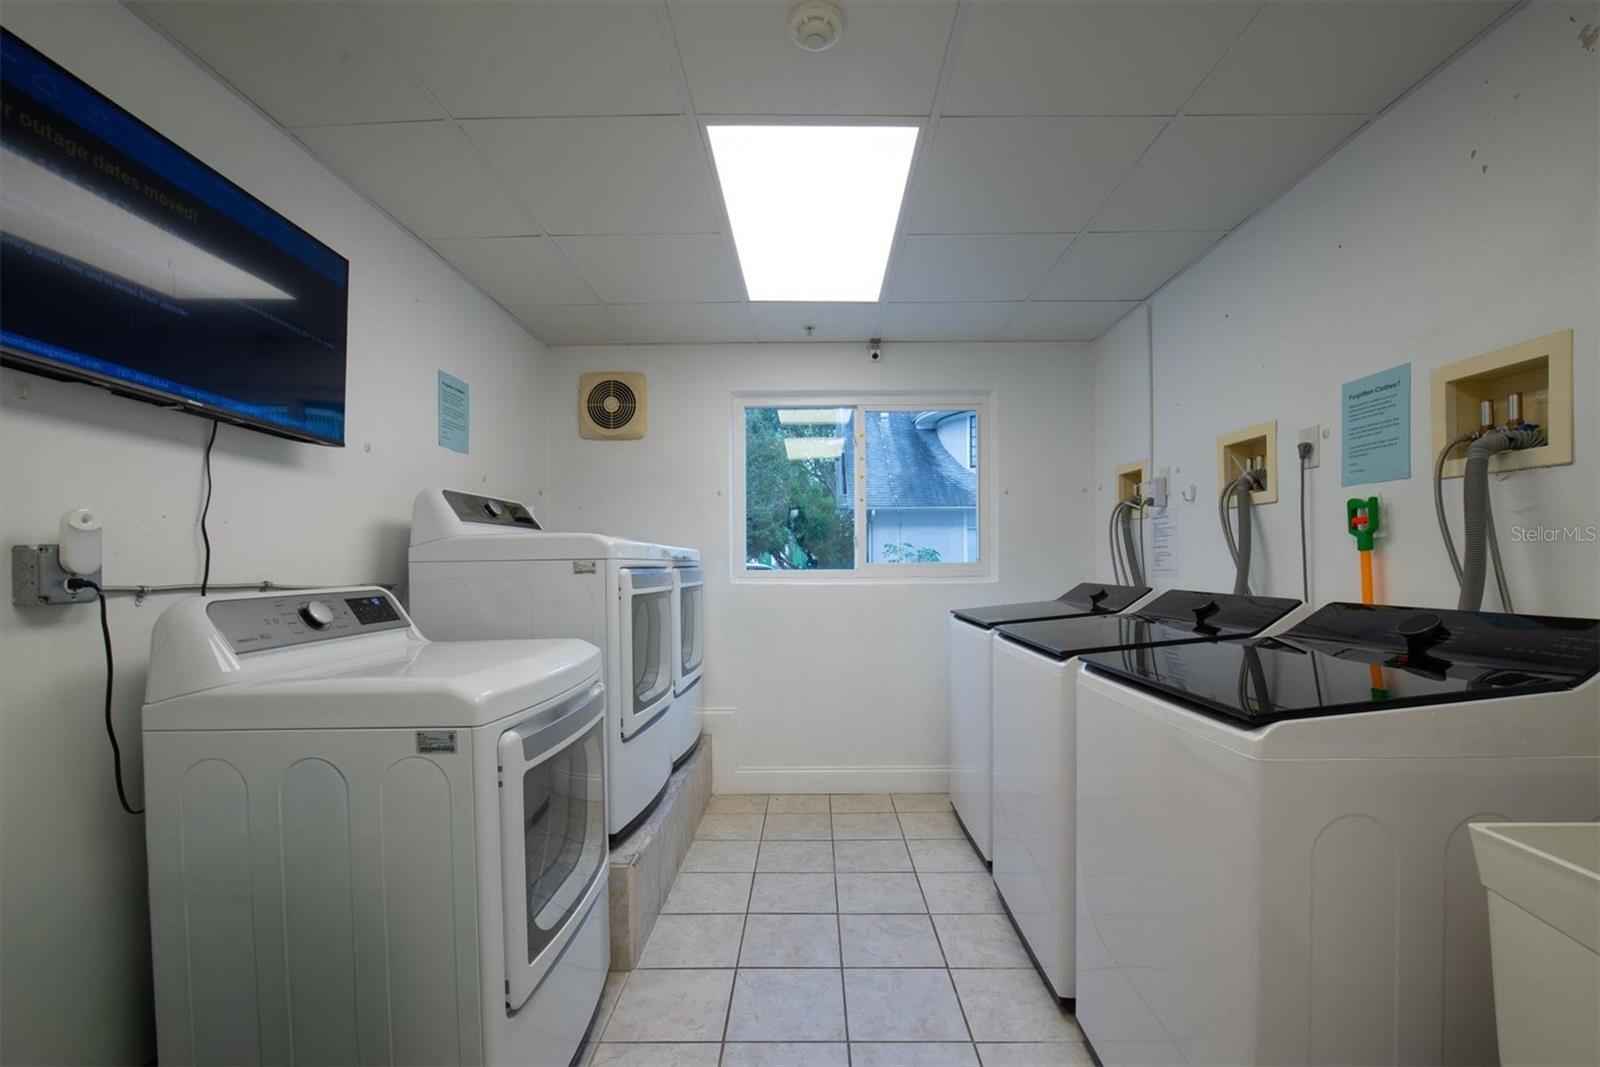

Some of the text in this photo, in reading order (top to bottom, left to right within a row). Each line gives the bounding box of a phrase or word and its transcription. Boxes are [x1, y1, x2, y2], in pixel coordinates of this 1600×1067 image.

[19, 113, 88, 160] outage
[94, 154, 140, 191] dates
[144, 184, 197, 224] moved!
[1348, 380, 1401, 401] Forgotten Clothes?
